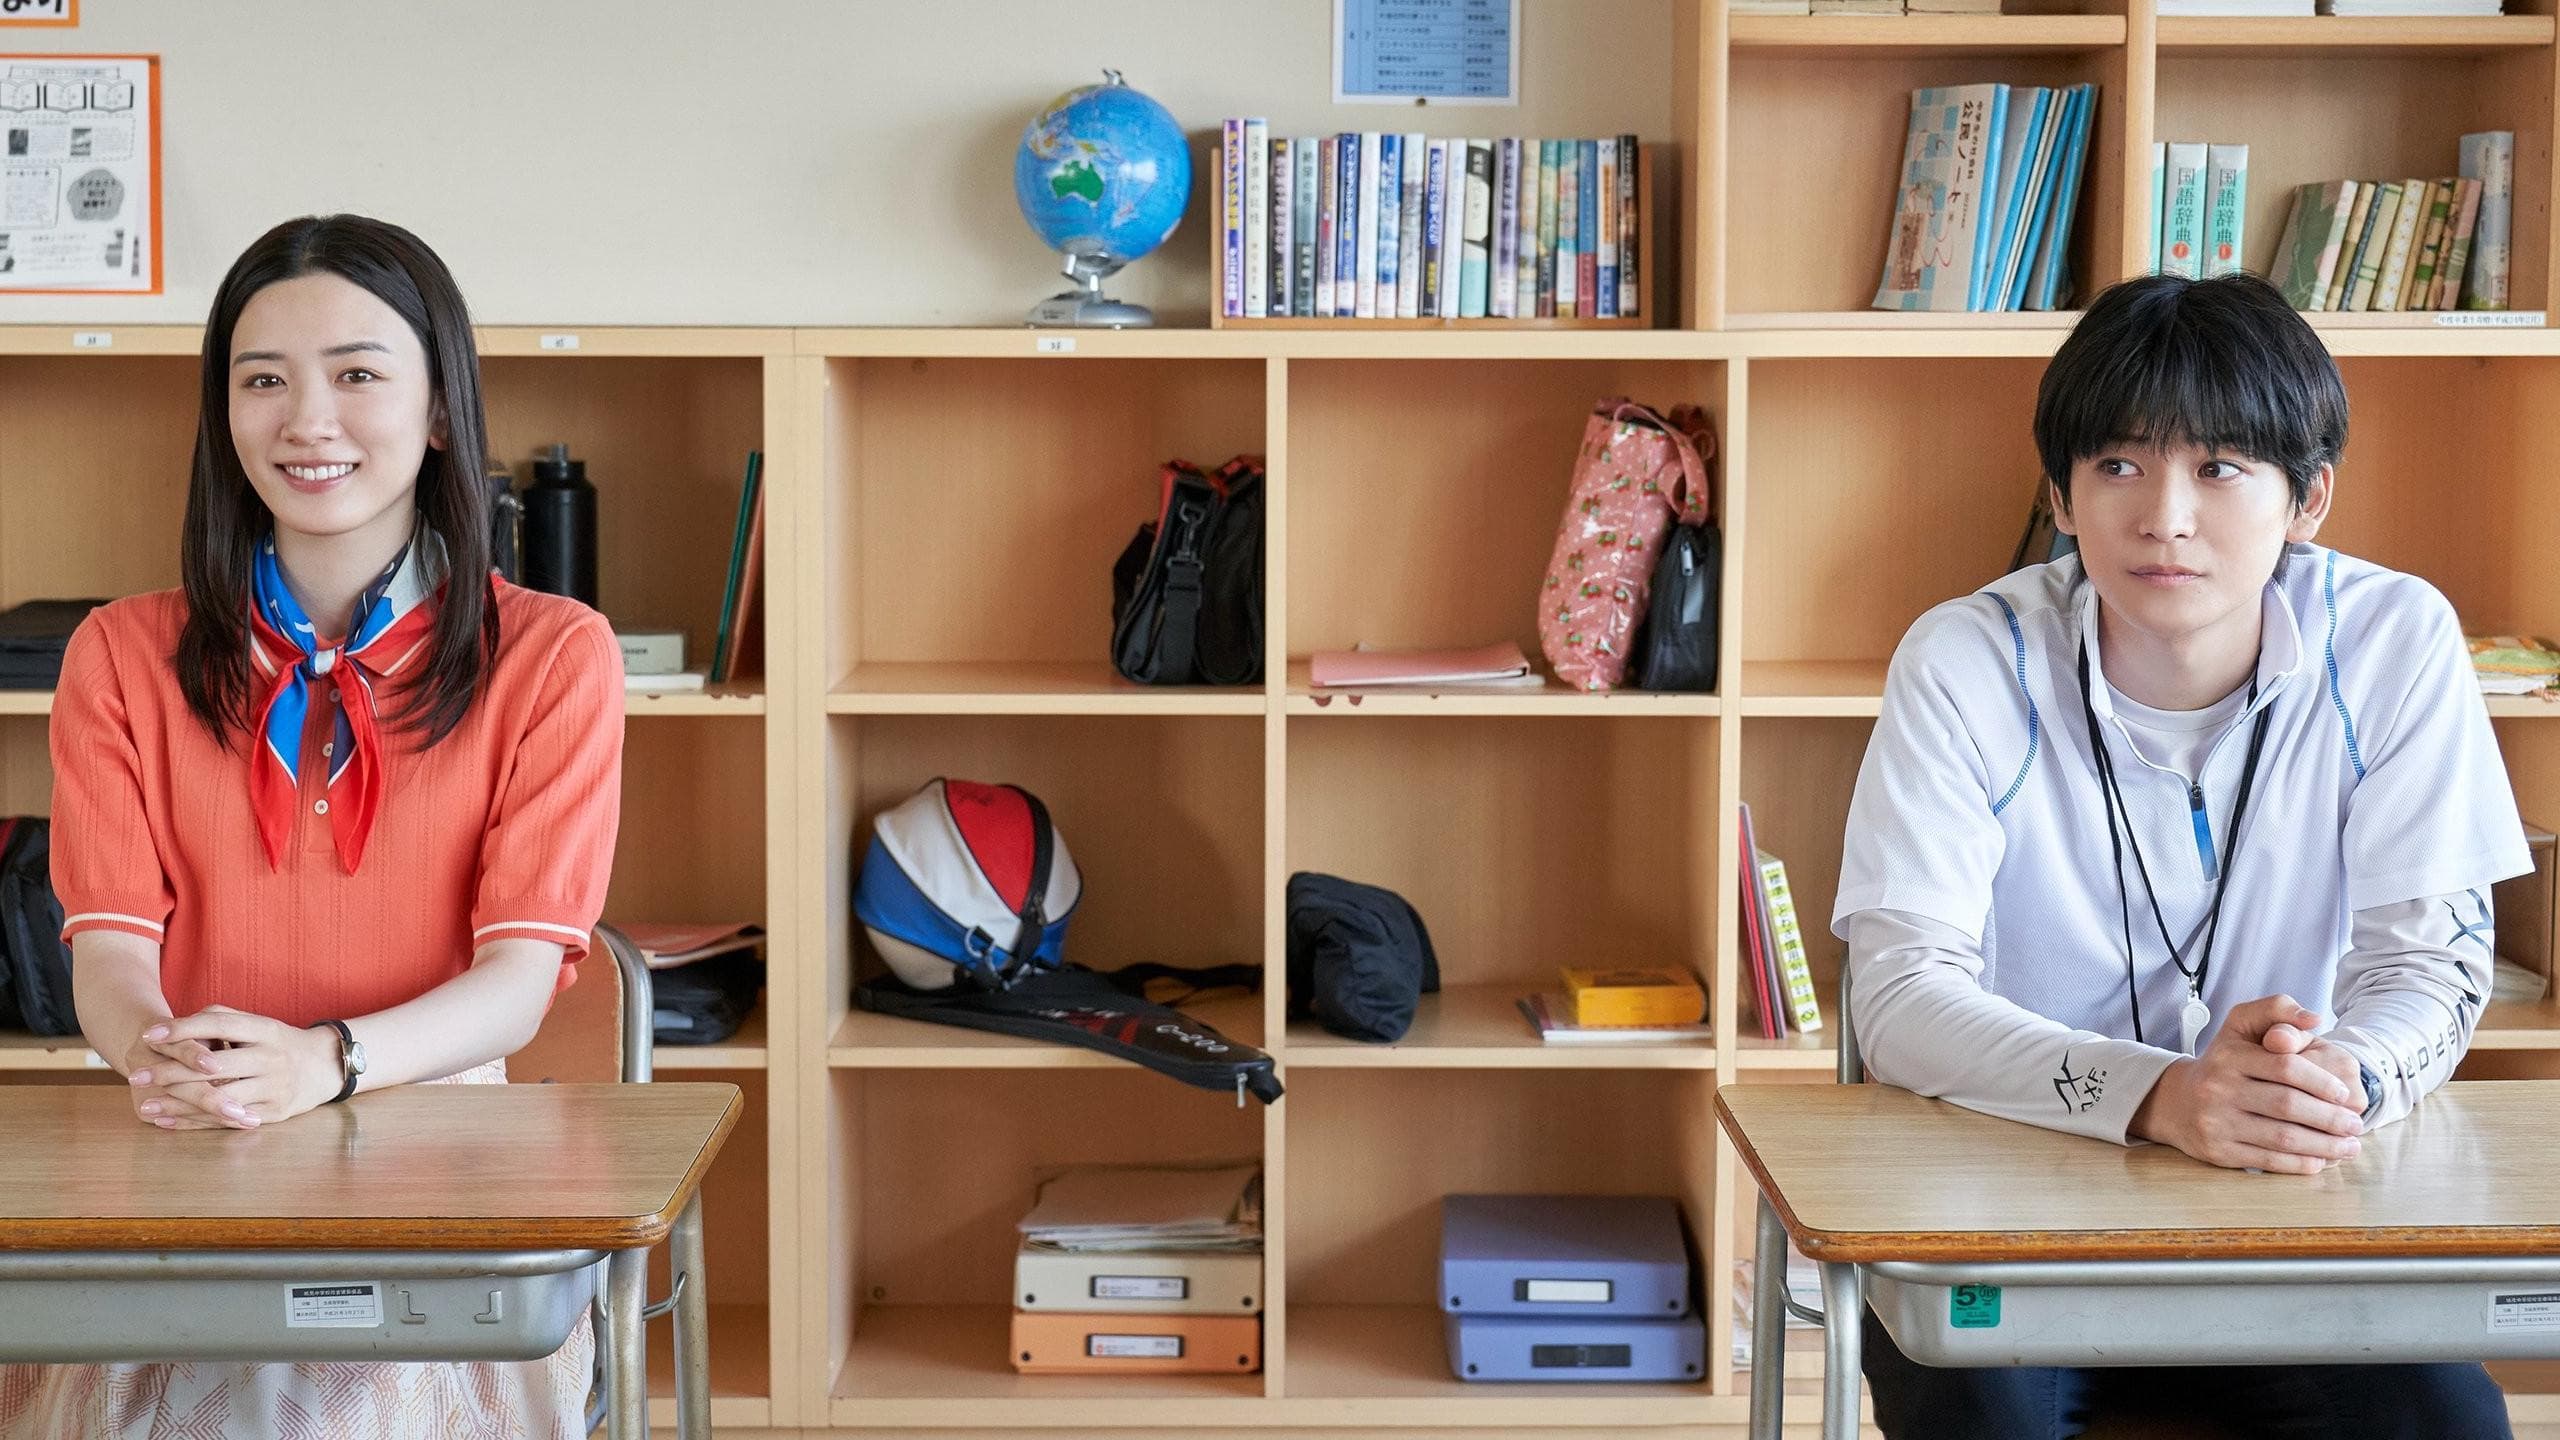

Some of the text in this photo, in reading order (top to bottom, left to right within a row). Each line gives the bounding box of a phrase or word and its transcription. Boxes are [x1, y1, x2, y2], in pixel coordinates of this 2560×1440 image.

[2175, 168, 2196, 246] 国語辞典
[2216, 168, 2237, 248] 国語辞典
[1955, 1285, 1976, 1306] 5
